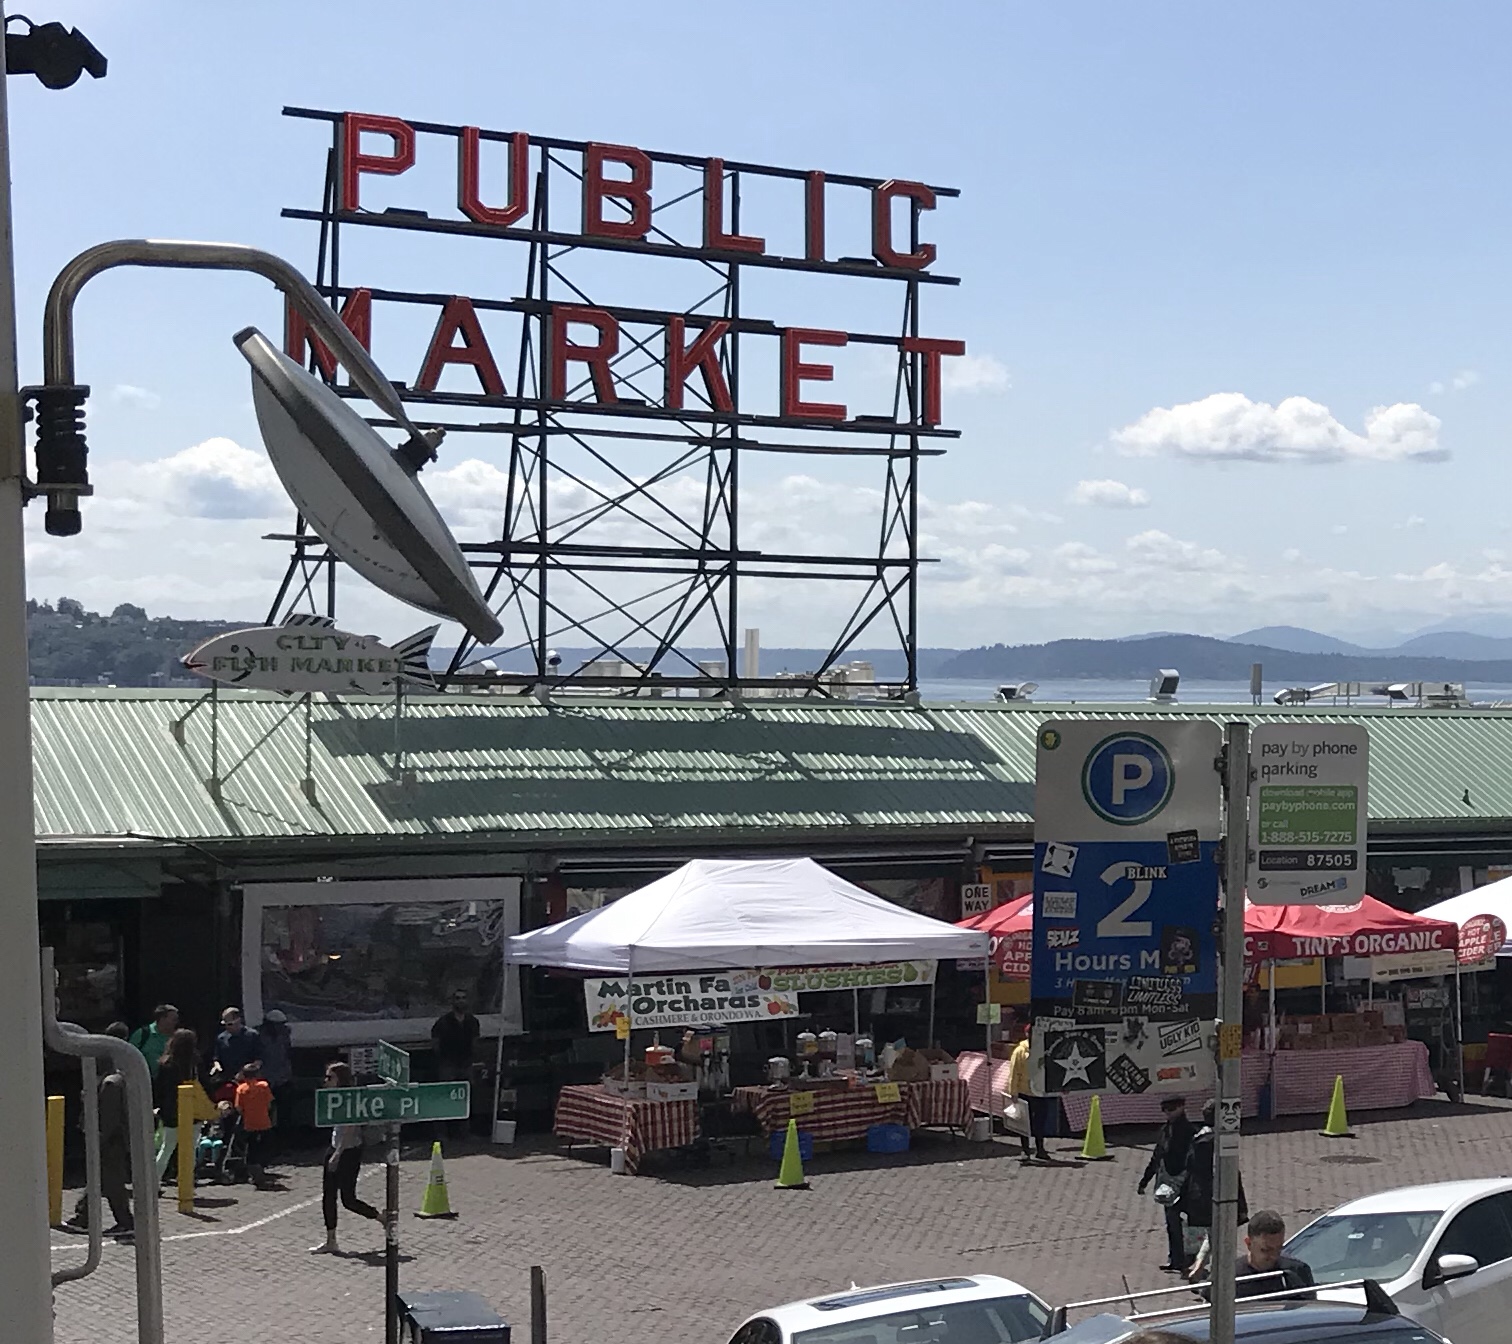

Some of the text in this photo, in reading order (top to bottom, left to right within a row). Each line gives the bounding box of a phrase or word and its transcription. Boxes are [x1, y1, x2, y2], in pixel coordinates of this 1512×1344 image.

[336, 112, 936, 270] PUBLIC
[284, 288, 966, 426] MARKET
[276, 635, 351, 651] CITY
[213, 655, 405, 674] FISH MARKET
[1261, 741, 1358, 757] pay by phone
[1261, 761, 1319, 779] parking
[1261, 800, 1356, 813] paybyphone.com
[1272, 819, 1289, 828] call
[1261, 831, 1353, 843] 1-888-515-7275
[1261, 854, 1352, 867] Location 87505
[1127, 866, 1168, 880] BLINK
[964, 886, 989, 899] ONE
[1096, 860, 1153, 938] 2
[964, 900, 990, 912] WAY
[1291, 930, 1443, 957] TINY'S ORGANIC
[1458, 934, 1487, 948] APPLE
[1458, 945, 1485, 958] CIDER
[1055, 951, 1131, 972] Hours
[772, 968, 905, 992] SLUSHIES
[597, 978, 692, 999] Martin
[1127, 990, 1182, 1006] LIMITLESS
[634, 1013, 690, 1026] CASHMERE
[691, 1013, 698, 1023] &
[700, 1009, 744, 1022] ORONDO
[1053, 1005, 1074, 1018] Pay
[1160, 1020, 1201, 1050] UGLY KID
[326, 1092, 385, 1121] Pike
[400, 1097, 420, 1116] Pl
